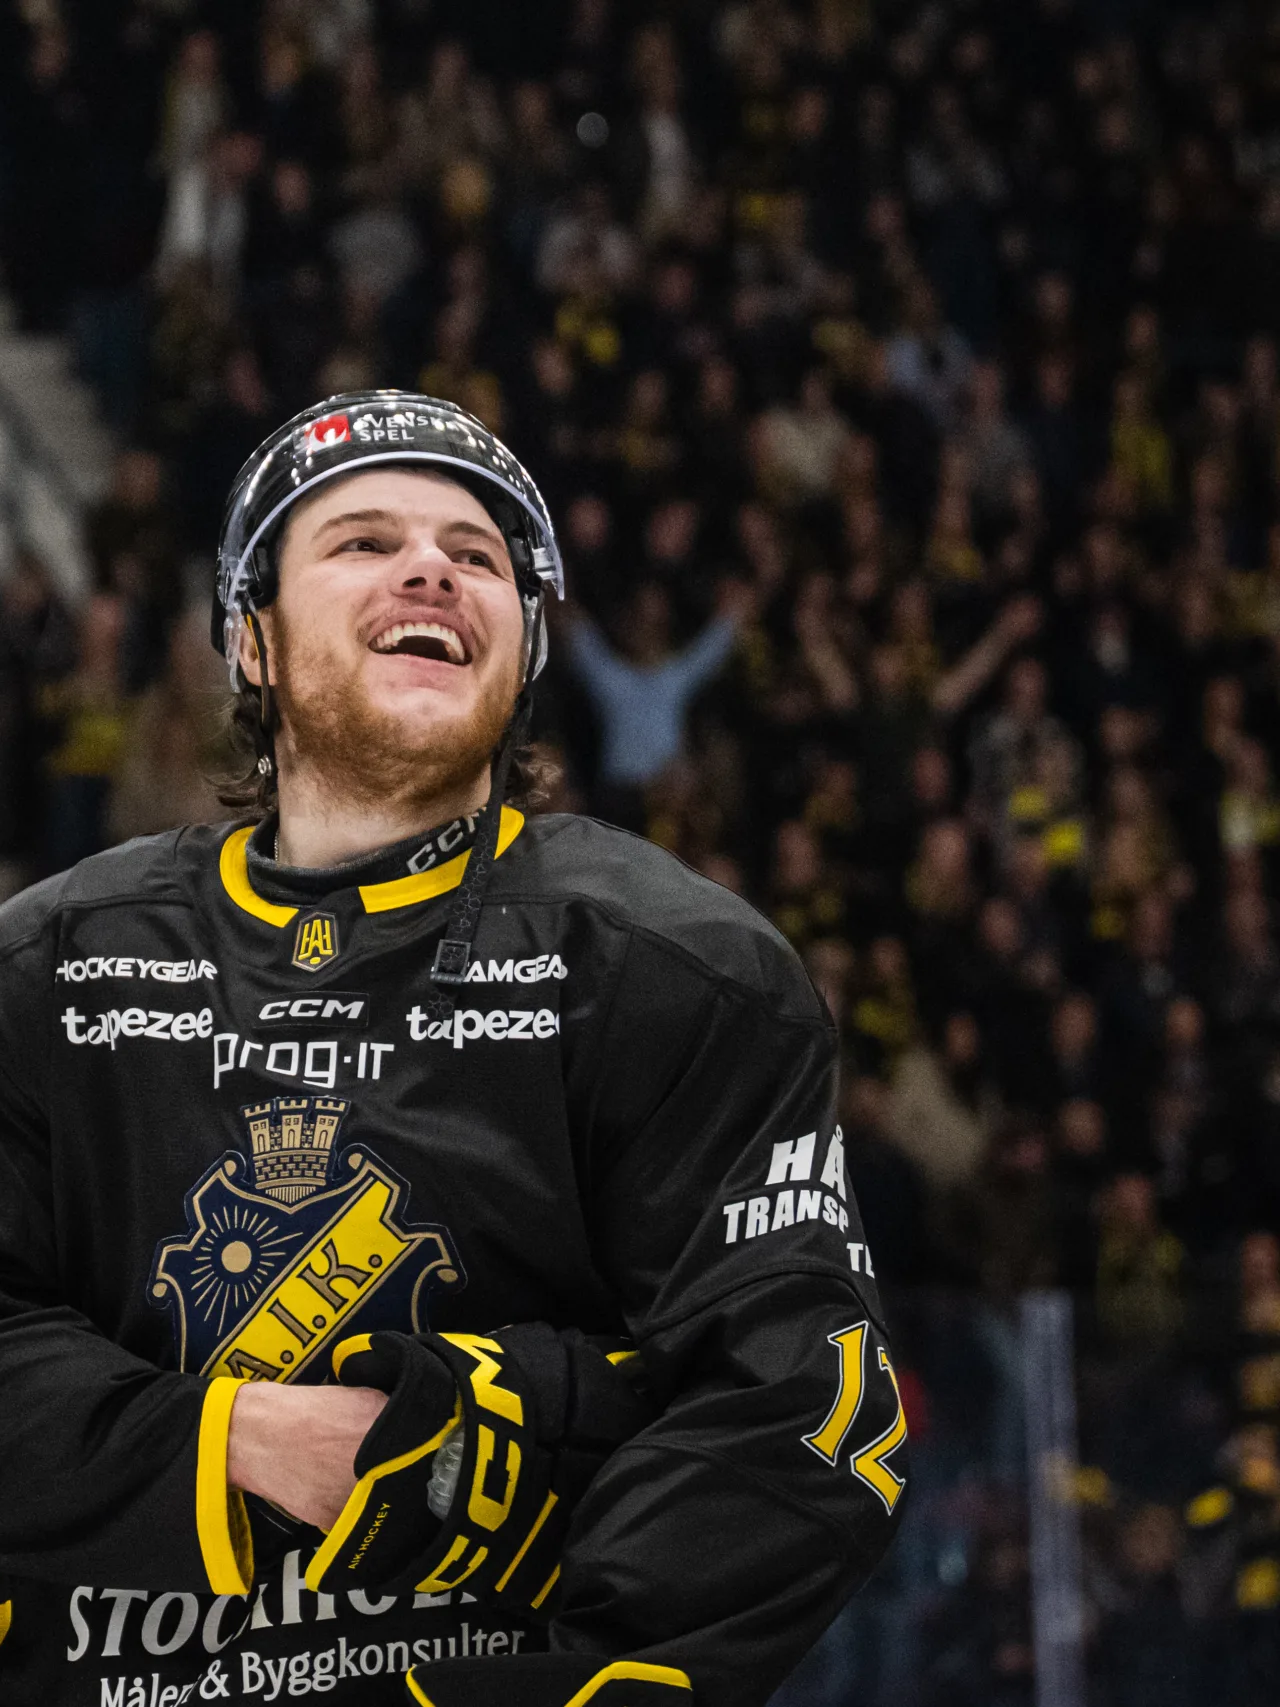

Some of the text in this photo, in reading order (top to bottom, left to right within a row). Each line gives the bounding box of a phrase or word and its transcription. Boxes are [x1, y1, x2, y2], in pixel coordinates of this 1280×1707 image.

[353, 411, 460, 432] SVENS
[360, 429, 415, 442] SPEL
[60, 1007, 214, 1051] tapezee
[258, 999, 366, 1021] CCM
[405, 1005, 560, 1049] tapeze
[764, 1124, 847, 1203] HÅ
[800, 1320, 908, 1517] 12
[414, 1332, 525, 1594] CCM
[358, 1502, 392, 1551] HOCKEY
[66, 1547, 478, 1662] STOCH
[200, 1659, 231, 1700] &
[240, 1622, 526, 1702] Byggkonsulter
